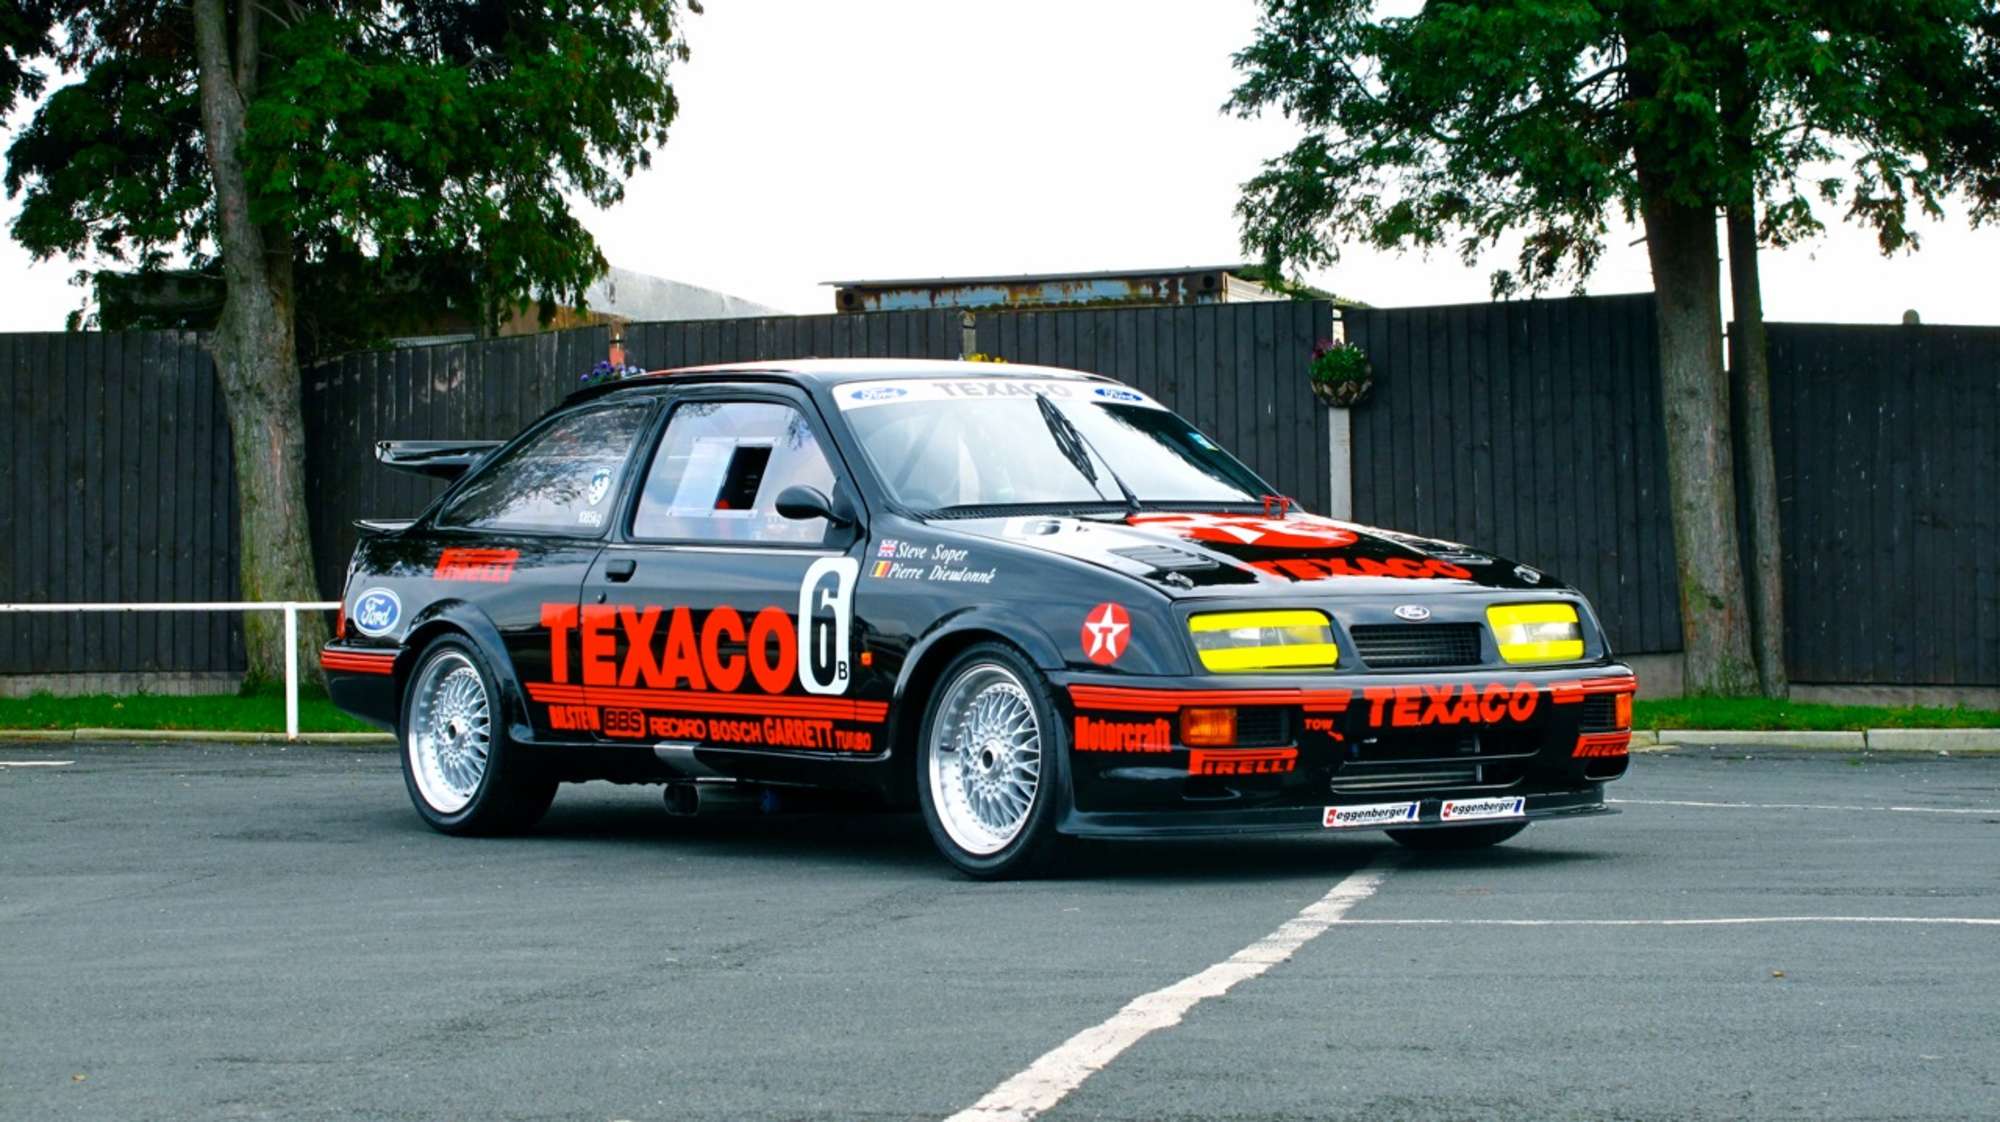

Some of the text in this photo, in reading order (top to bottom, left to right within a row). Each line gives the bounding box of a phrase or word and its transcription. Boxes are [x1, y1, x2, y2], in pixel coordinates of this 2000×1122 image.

[932, 382, 1072, 398] TEXACO
[896, 542, 968, 563] Steve Soper
[433, 548, 519, 583] PIRELLI
[888, 563, 996, 584] Pierre Dieudonné
[1238, 557, 1473, 582] TEXACO
[360, 597, 392, 626] Ford
[810, 570, 841, 687] 6
[540, 603, 797, 694] TEXACO
[838, 661, 848, 680] B
[1362, 682, 1540, 727] TEXACO
[548, 705, 872, 751] BILSTEIN BBS RECARO BOSCH GARRETT TURBO
[1074, 716, 1172, 752] Motorcraft
[1304, 719, 1333, 731] TOW
[1572, 733, 1631, 758] PIRELL
[1188, 749, 1298, 776] PIRELLI
[1336, 807, 1408, 823] eggenberger
[1451, 800, 1515, 816] eggenberger
